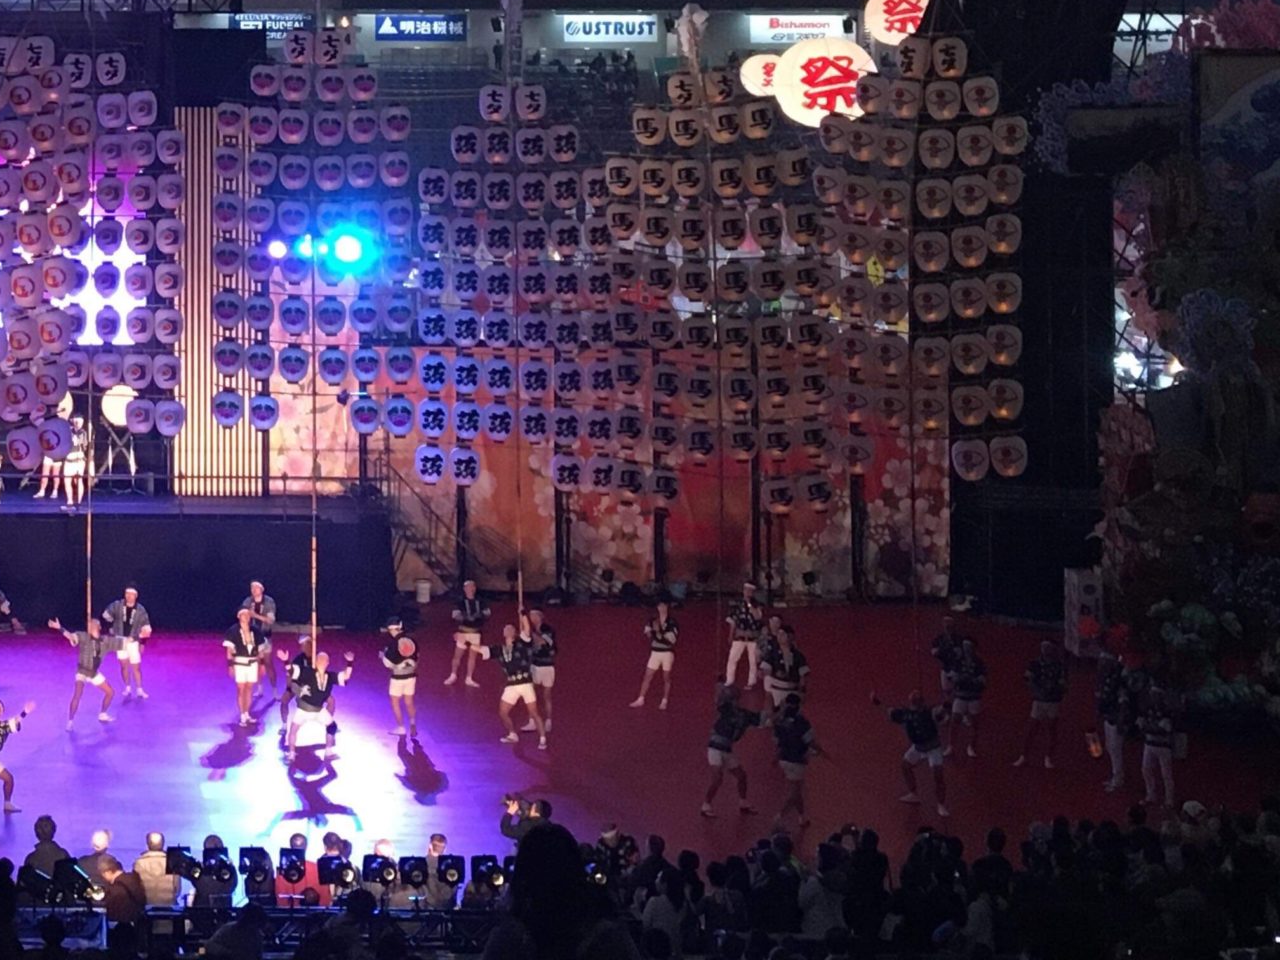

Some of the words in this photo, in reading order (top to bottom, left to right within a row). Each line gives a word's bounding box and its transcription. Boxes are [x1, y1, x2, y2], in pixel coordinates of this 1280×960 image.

[399, 20, 463, 35] 明治機械
[582, 20, 656, 36] USTRUST
[290, 34, 307, 60] 七夕
[321, 34, 340, 62] 七夕
[104, 57, 120, 81] 七夕
[799, 55, 860, 113] 祭
[487, 90, 503, 115] 七夕
[524, 90, 541, 114] 七夕
